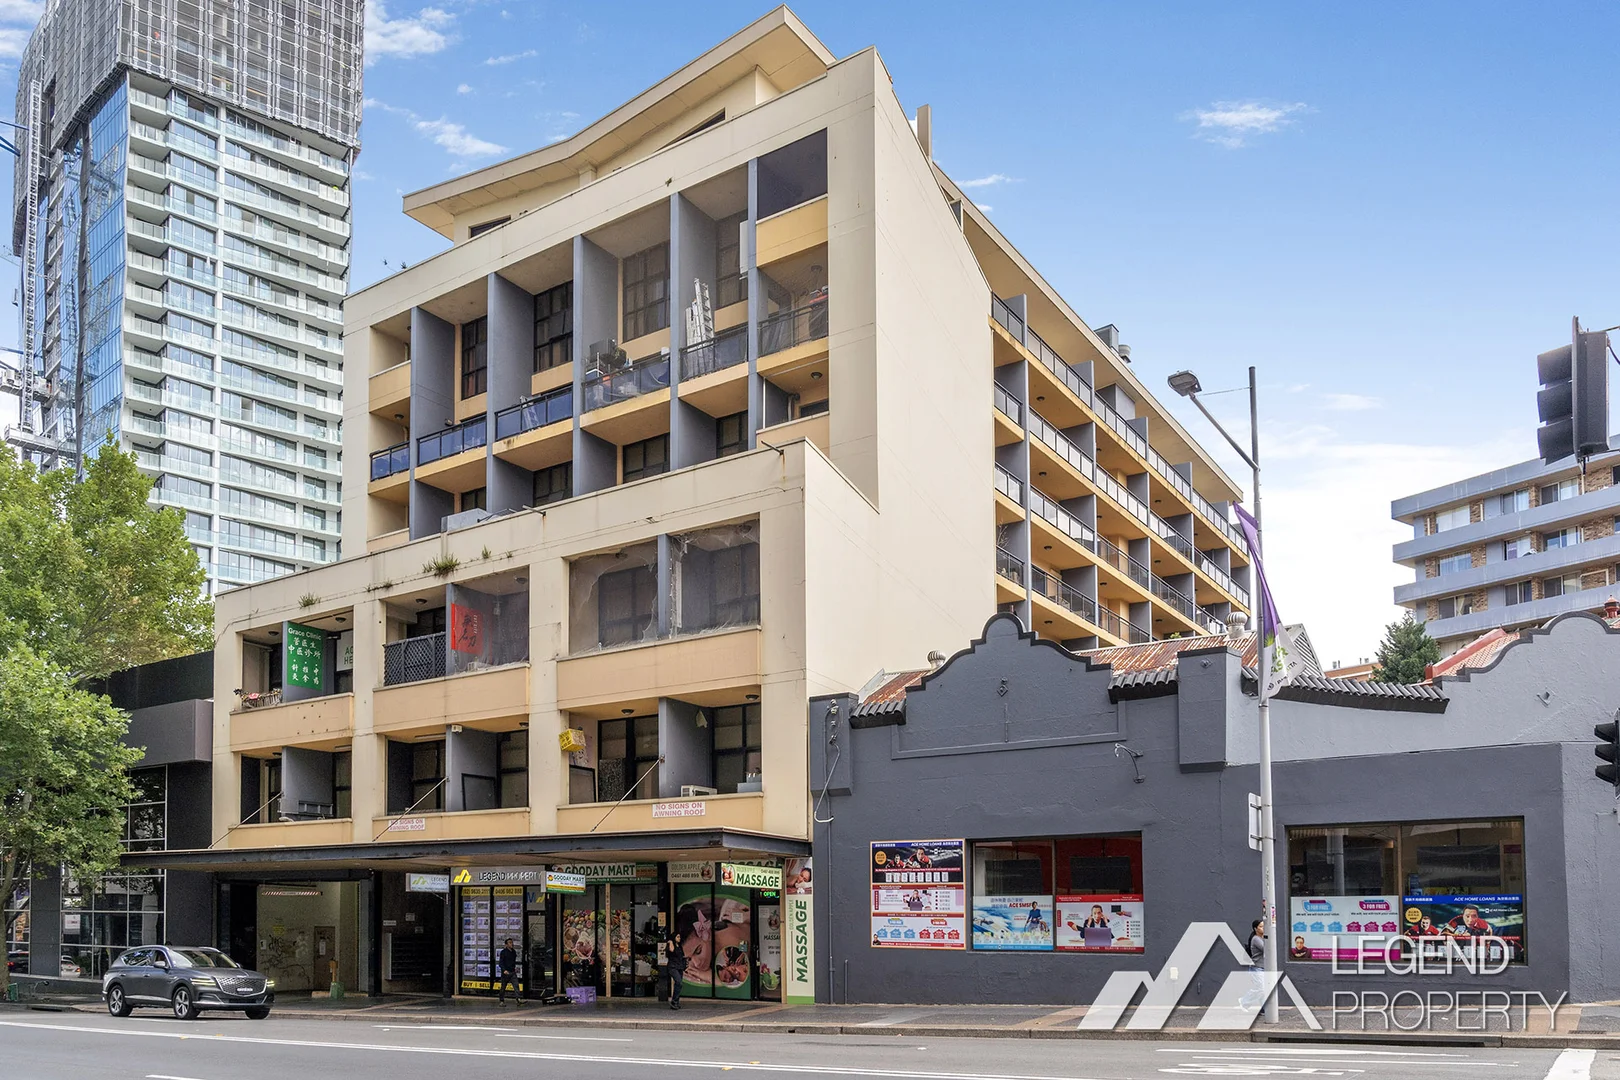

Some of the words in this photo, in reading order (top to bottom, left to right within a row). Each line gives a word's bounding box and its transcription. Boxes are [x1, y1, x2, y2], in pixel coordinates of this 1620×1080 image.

[288, 628, 304, 636] Grace
[306, 632, 321, 640] Clinic
[565, 865, 605, 876] GOODAY
[608, 863, 635, 876] MART
[479, 872, 505, 882] LEGEND
[736, 873, 779, 887] MASSAGE
[796, 900, 808, 982] MASSAGE
